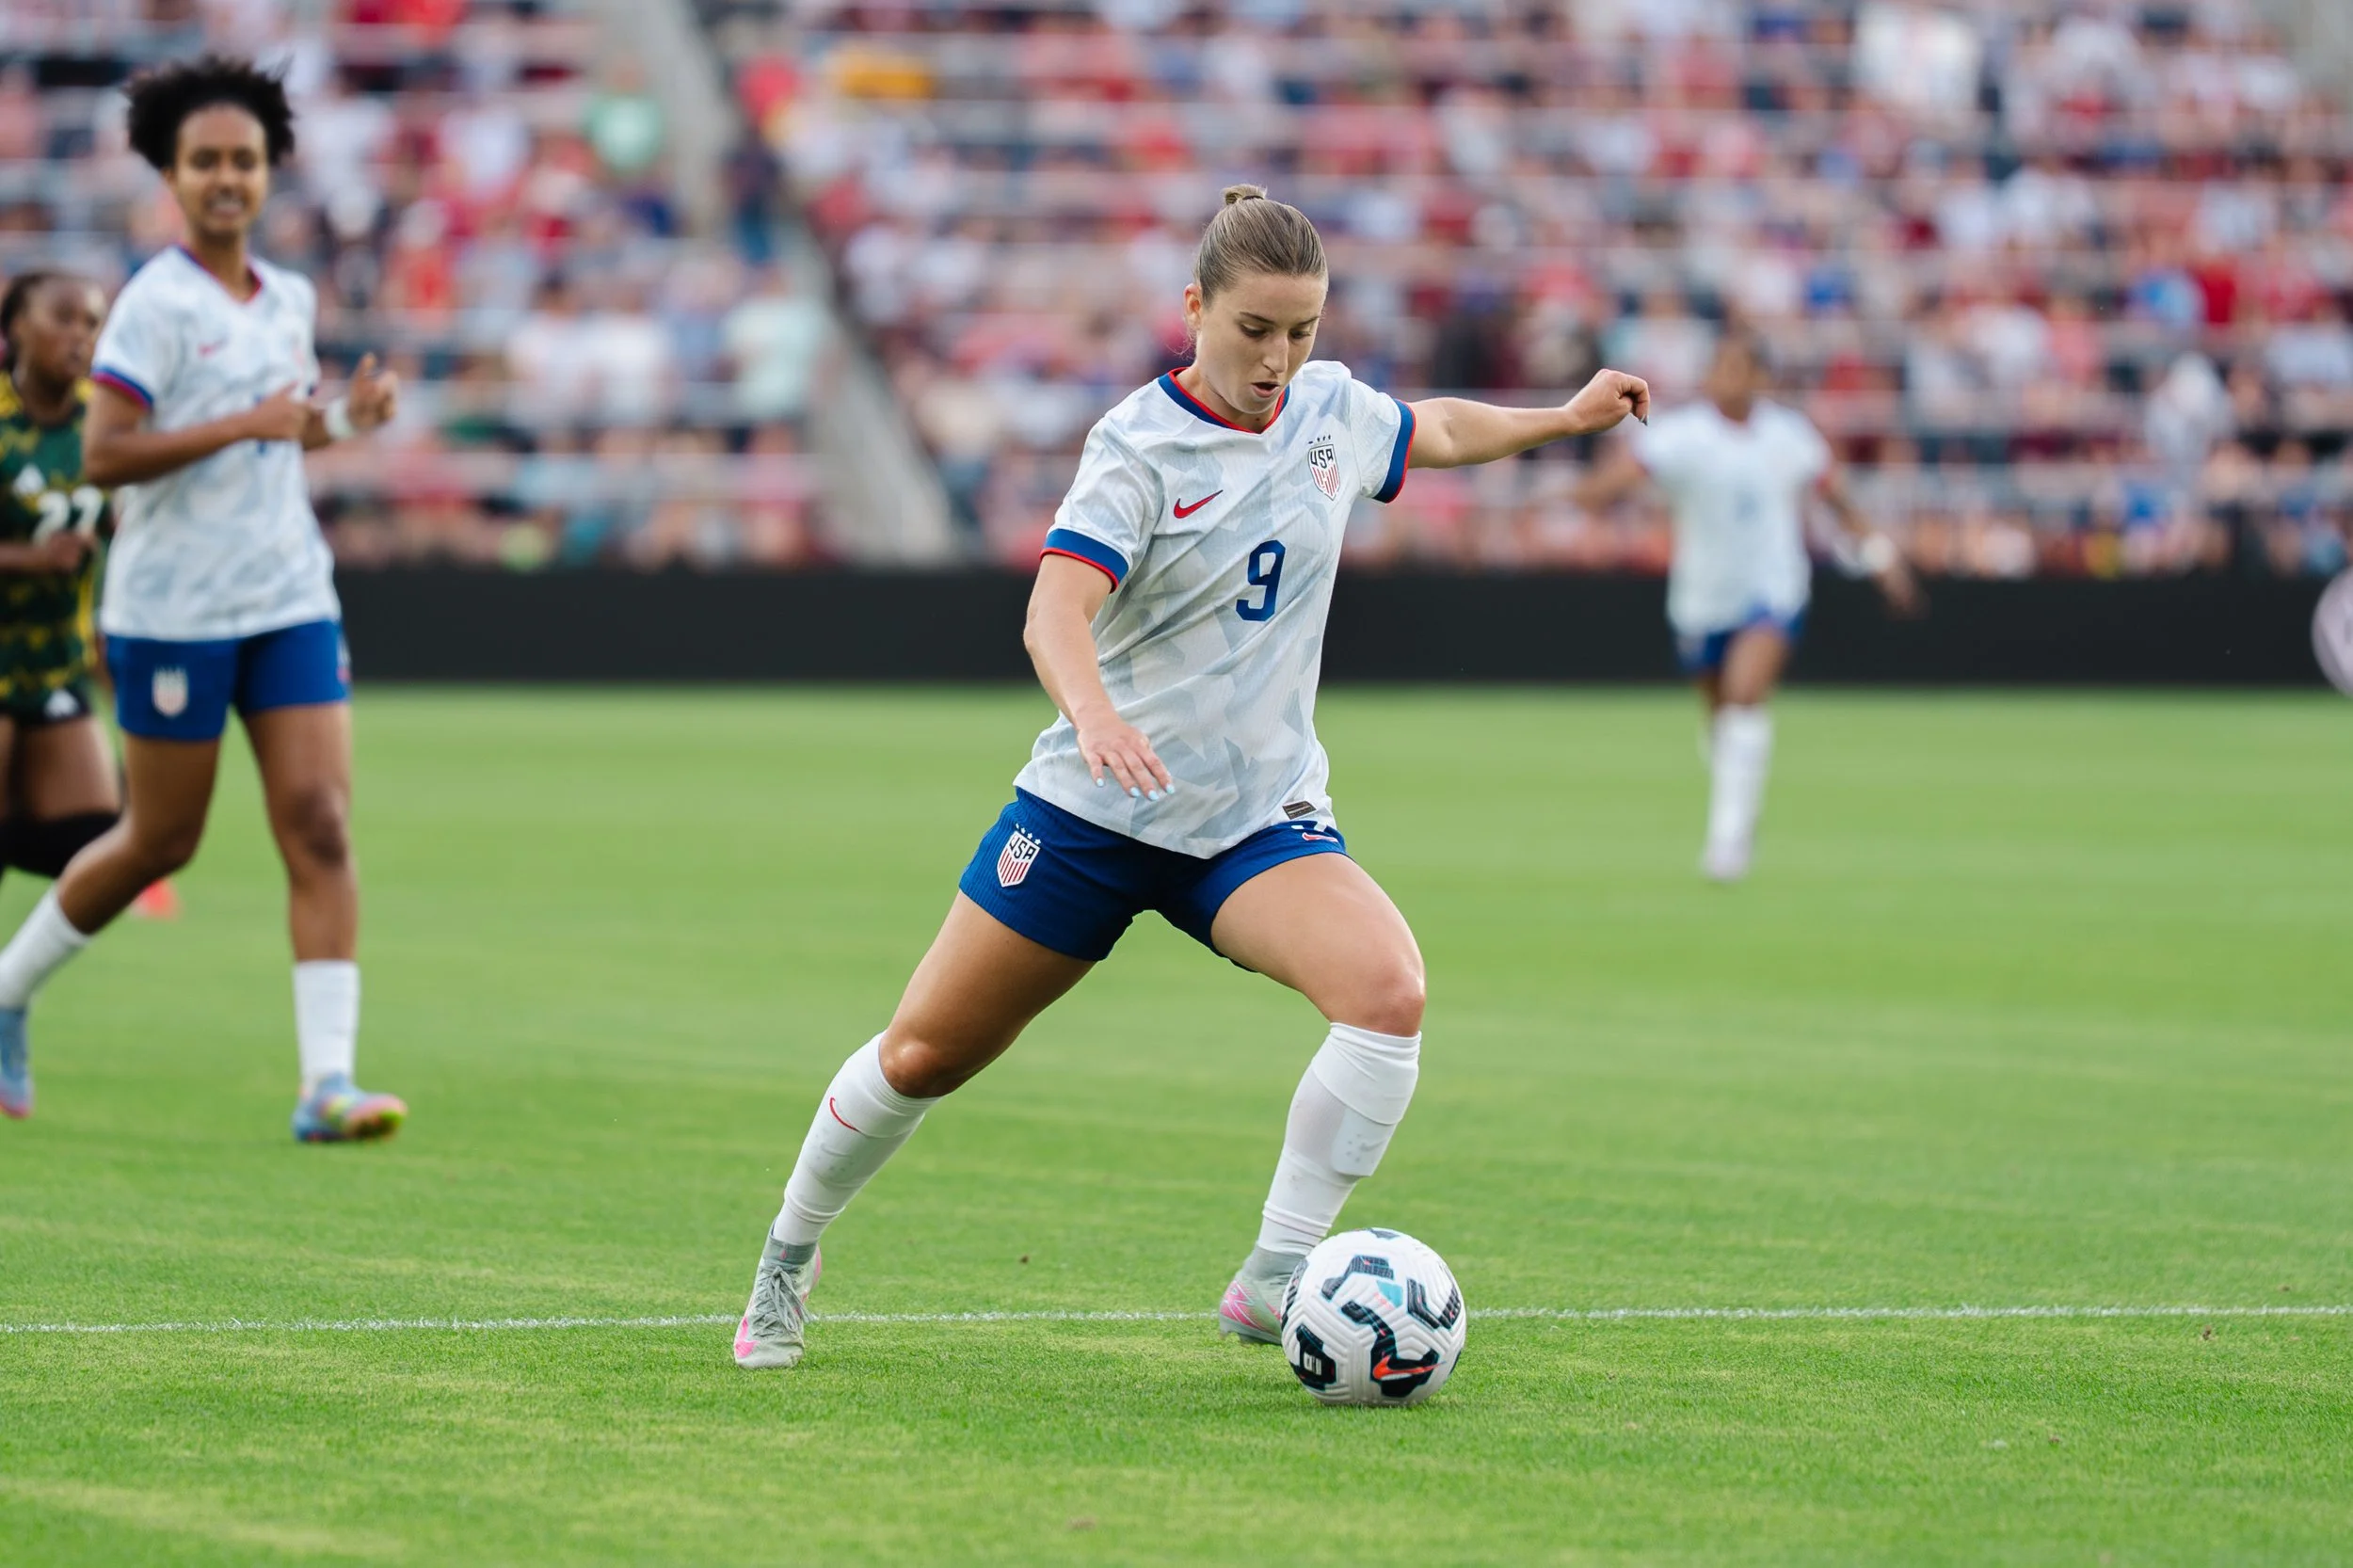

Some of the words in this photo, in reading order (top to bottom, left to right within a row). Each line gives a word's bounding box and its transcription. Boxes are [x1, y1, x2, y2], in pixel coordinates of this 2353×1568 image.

[1310, 448, 1334, 469] USA
[1236, 539, 1286, 622] 9
[1009, 835, 1036, 860] USA
